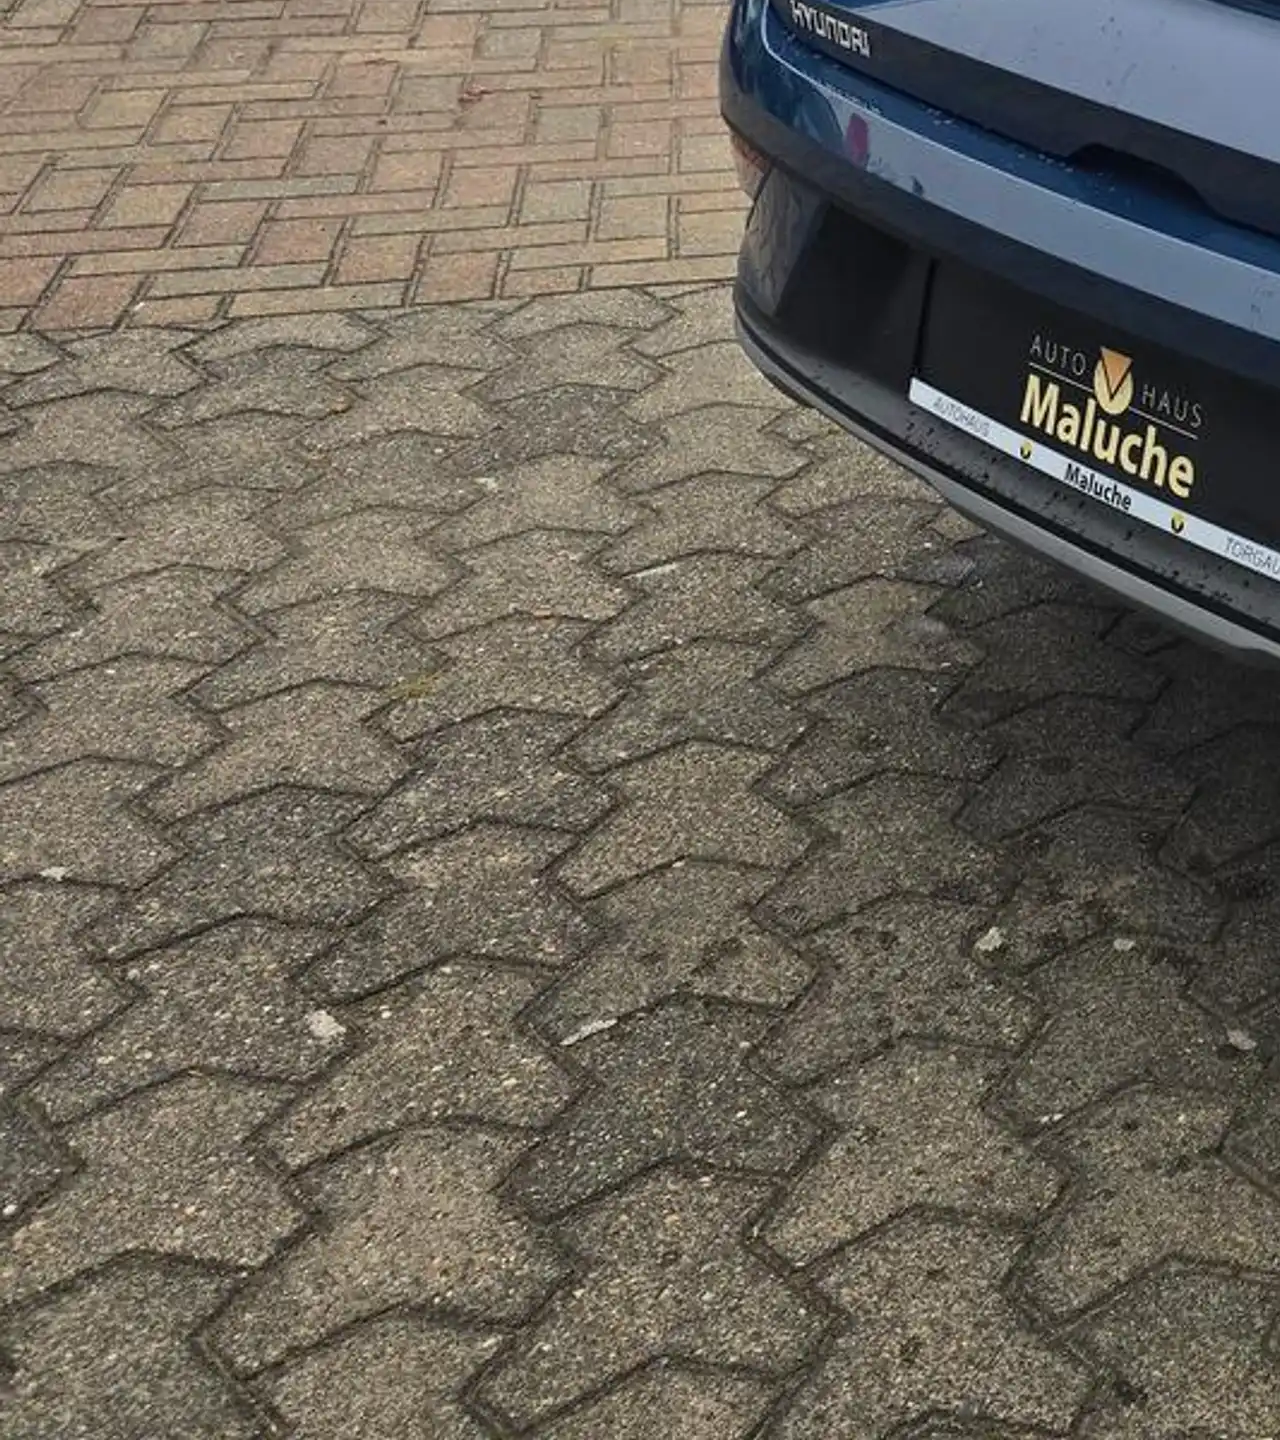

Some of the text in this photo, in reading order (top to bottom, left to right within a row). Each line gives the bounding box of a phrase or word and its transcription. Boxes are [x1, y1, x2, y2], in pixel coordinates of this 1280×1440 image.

[1029, 334, 1203, 429] AUTO HAUS
[1019, 373, 1196, 499] Maluche
[1064, 462, 1132, 511] Maluche
